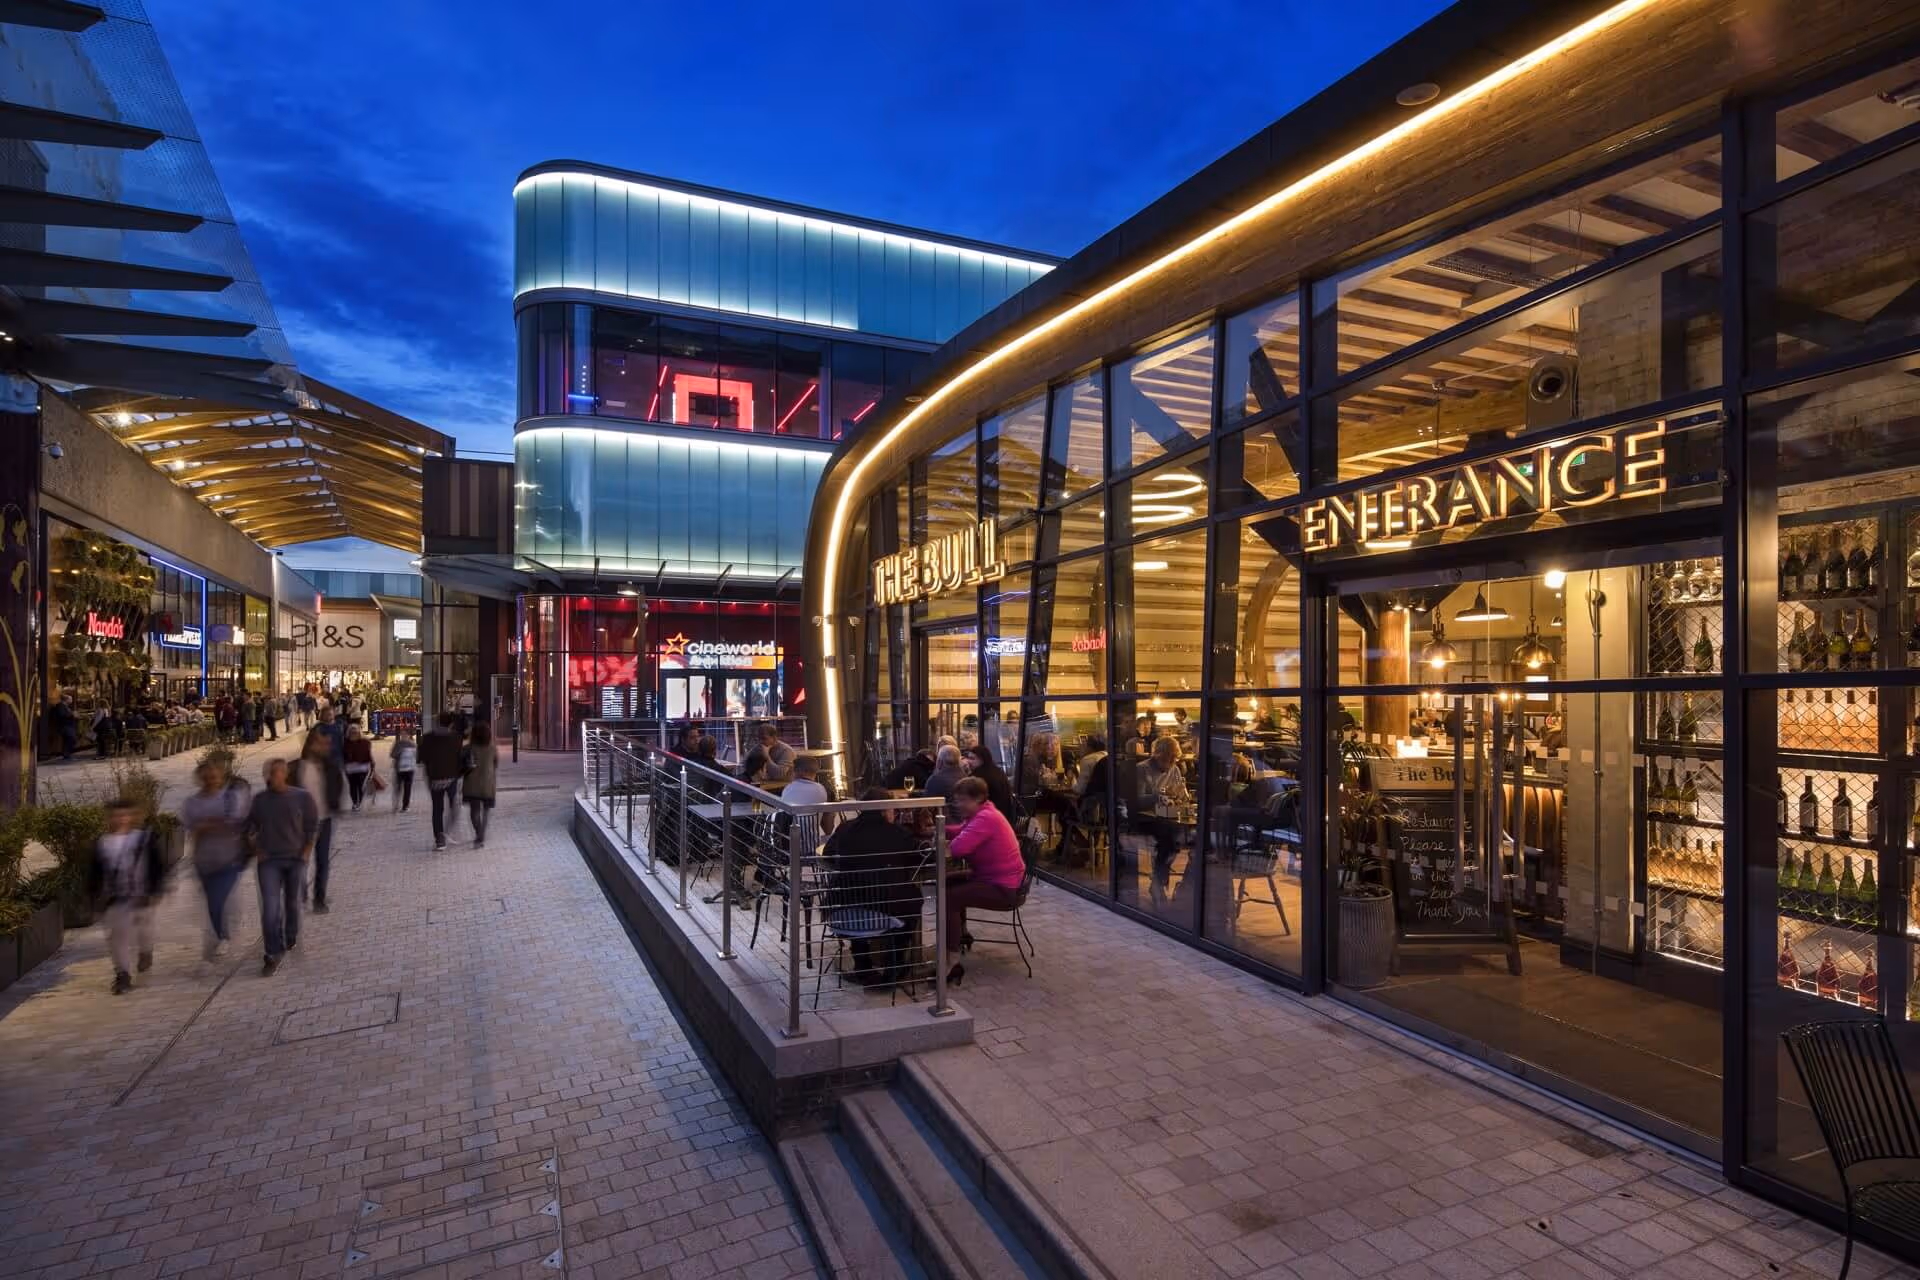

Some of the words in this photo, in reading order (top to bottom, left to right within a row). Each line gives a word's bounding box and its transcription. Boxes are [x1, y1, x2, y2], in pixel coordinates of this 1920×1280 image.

[1304, 419, 1667, 552] ENTRANCE
[873, 546, 919, 605] THE
[921, 518, 1007, 595] BULL
[88, 611, 124, 639] Nando's
[687, 640, 776, 655] cineworld
[1416, 900, 1451, 919] Thank
